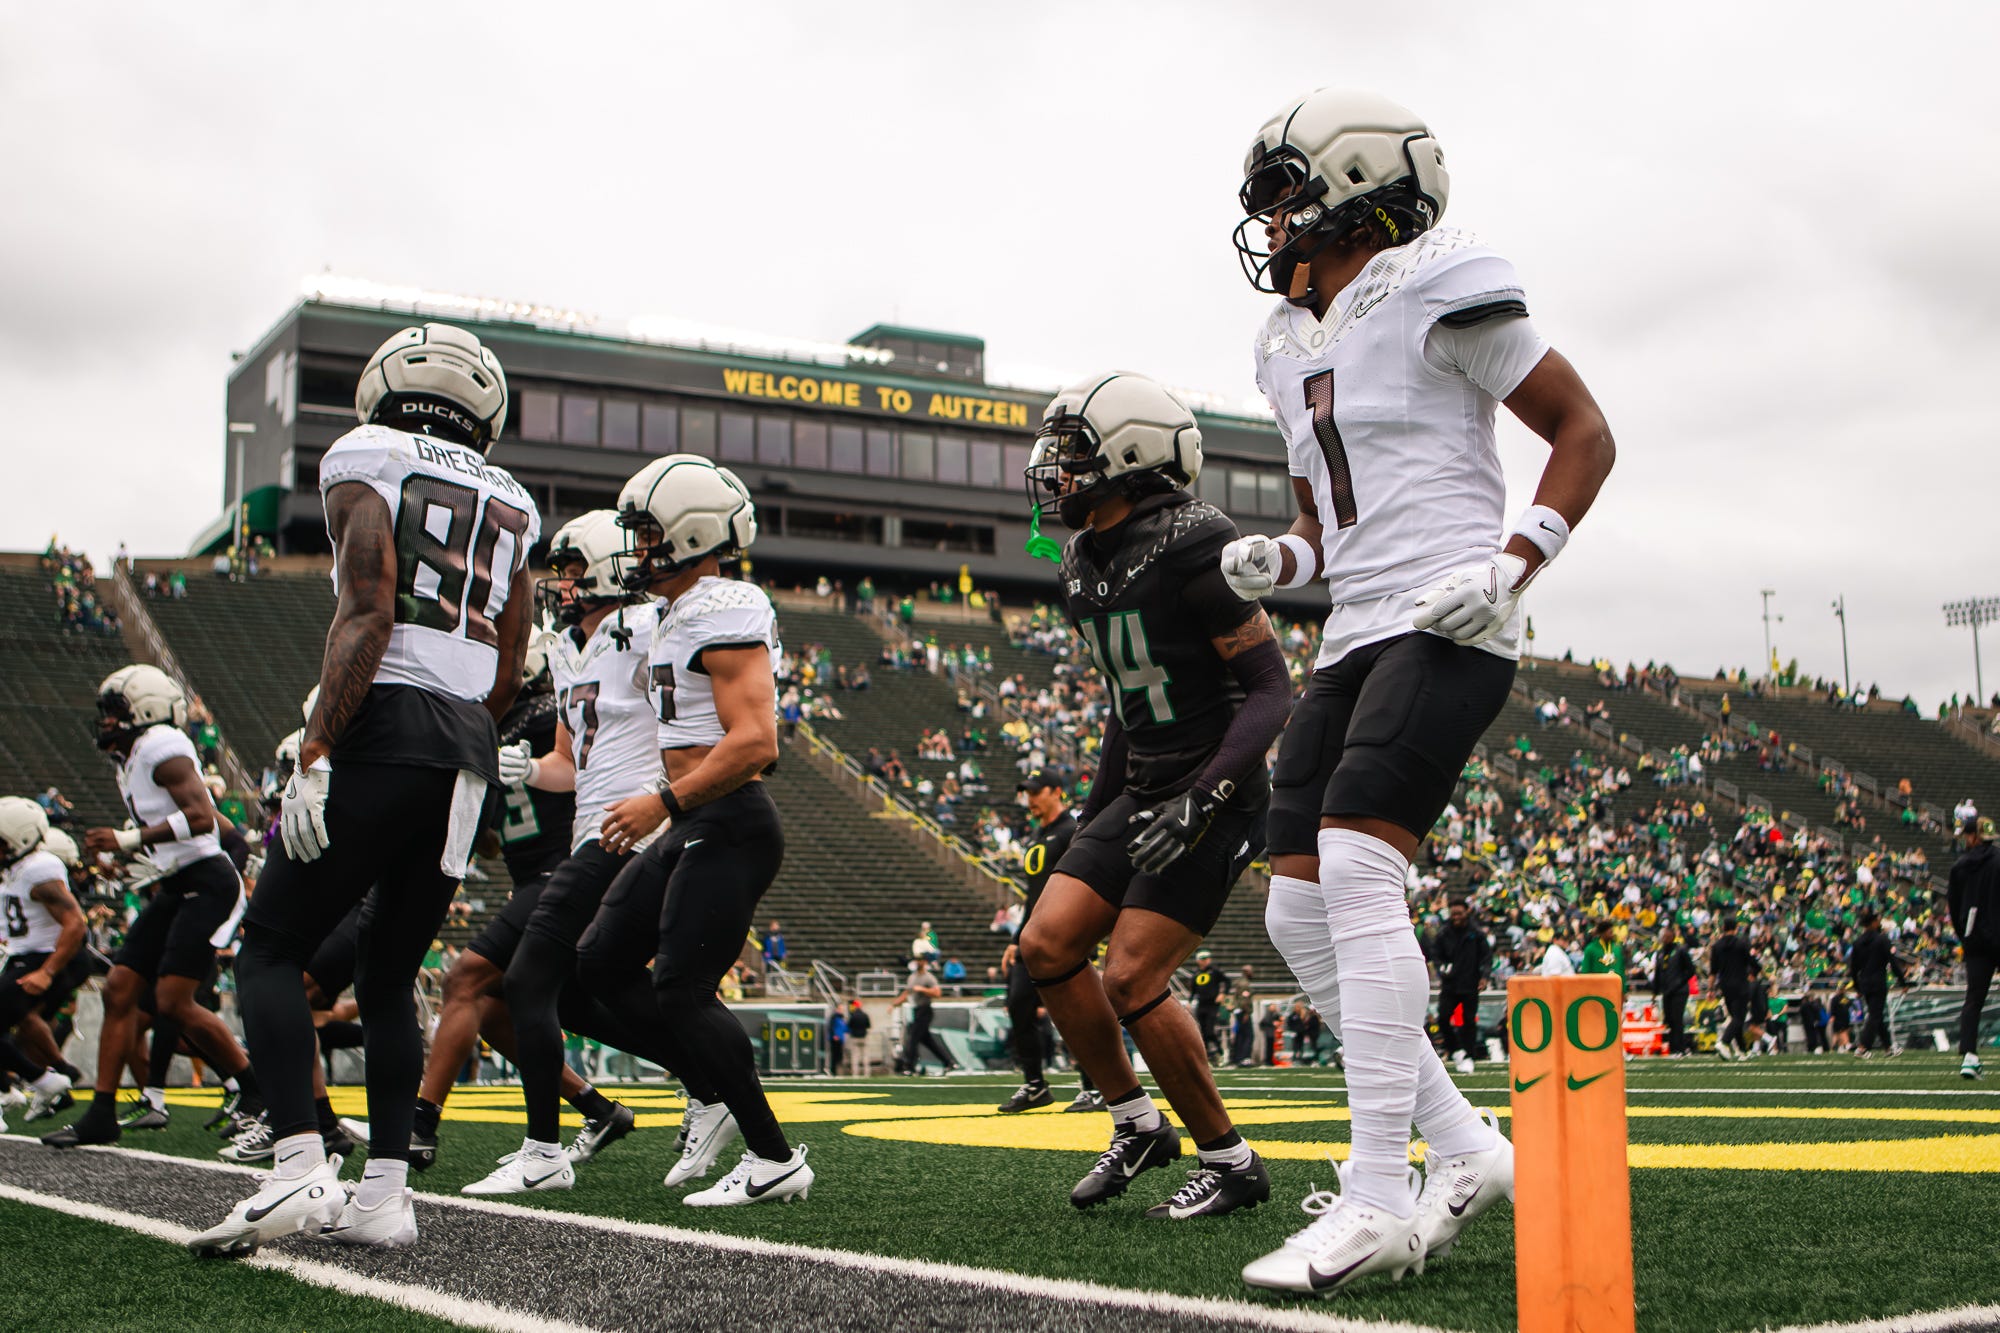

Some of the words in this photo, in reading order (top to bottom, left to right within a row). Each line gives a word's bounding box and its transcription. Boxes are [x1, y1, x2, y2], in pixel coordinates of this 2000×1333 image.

[402, 403, 475, 432] DUCKS
[723, 368, 861, 407] WELCOME
[877, 386, 912, 413] TO
[928, 393, 1028, 427] AUTZEN
[1303, 368, 1358, 531] 1
[394, 472, 530, 650] 80
[1079, 609, 1176, 730] 14
